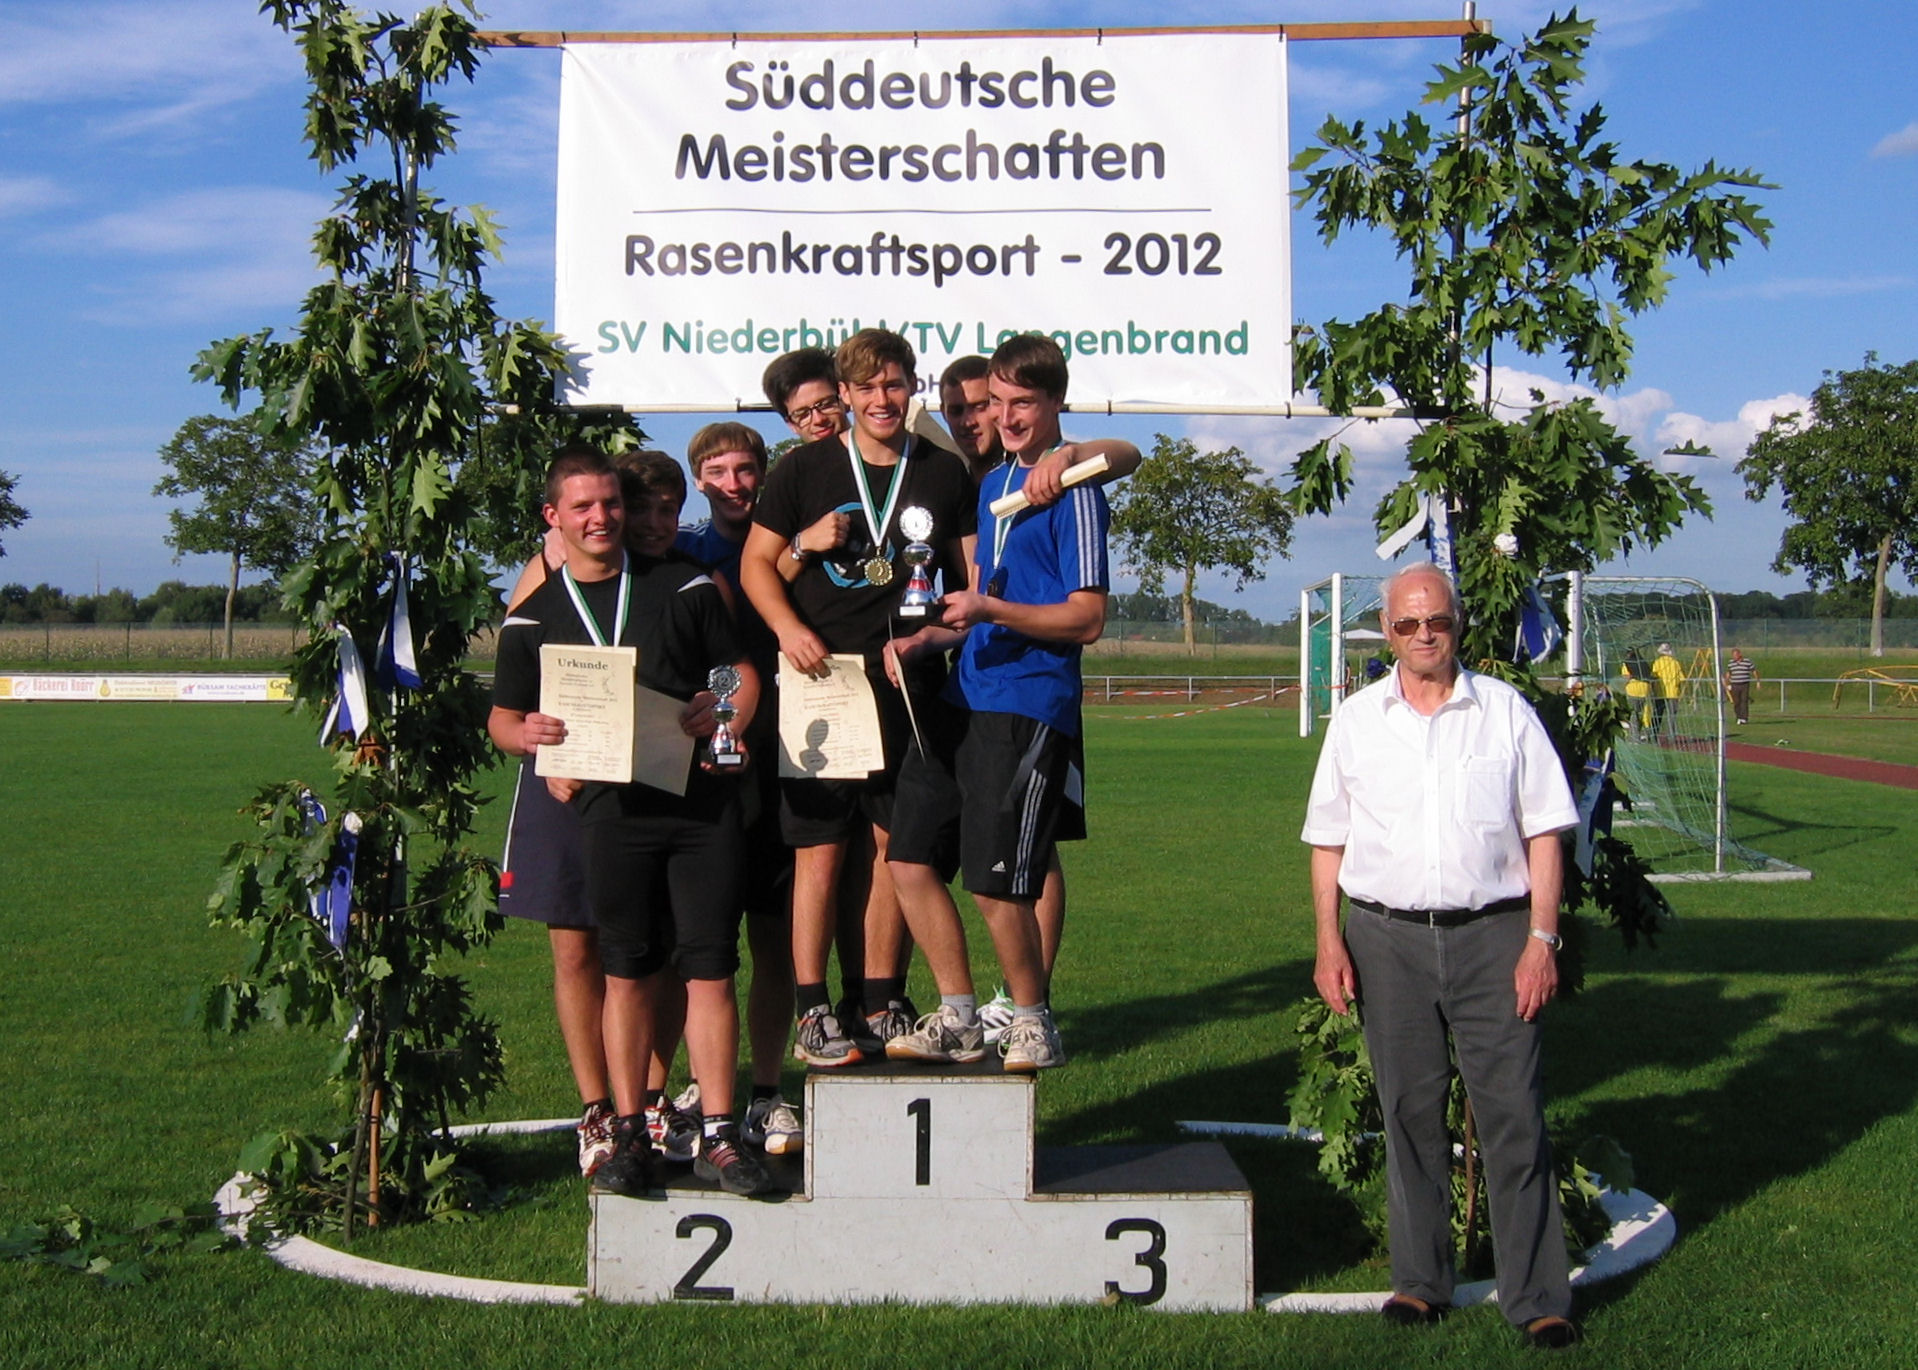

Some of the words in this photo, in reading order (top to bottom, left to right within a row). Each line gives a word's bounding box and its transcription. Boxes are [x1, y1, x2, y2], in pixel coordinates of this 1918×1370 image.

[725, 56, 1117, 111] Süddeutsche
[674, 129, 1166, 183] Meisterschaften
[625, 230, 1041, 288] Rasenkraftsport
[1103, 232, 1223, 276] 2012
[597, 321, 648, 355] SV
[977, 320, 1249, 361] Lagenbrand
[558, 658, 609, 671] Urkunde
[907, 1098, 931, 1185] 1
[674, 1214, 734, 1300] 2
[1105, 1218, 1167, 1306] 3
